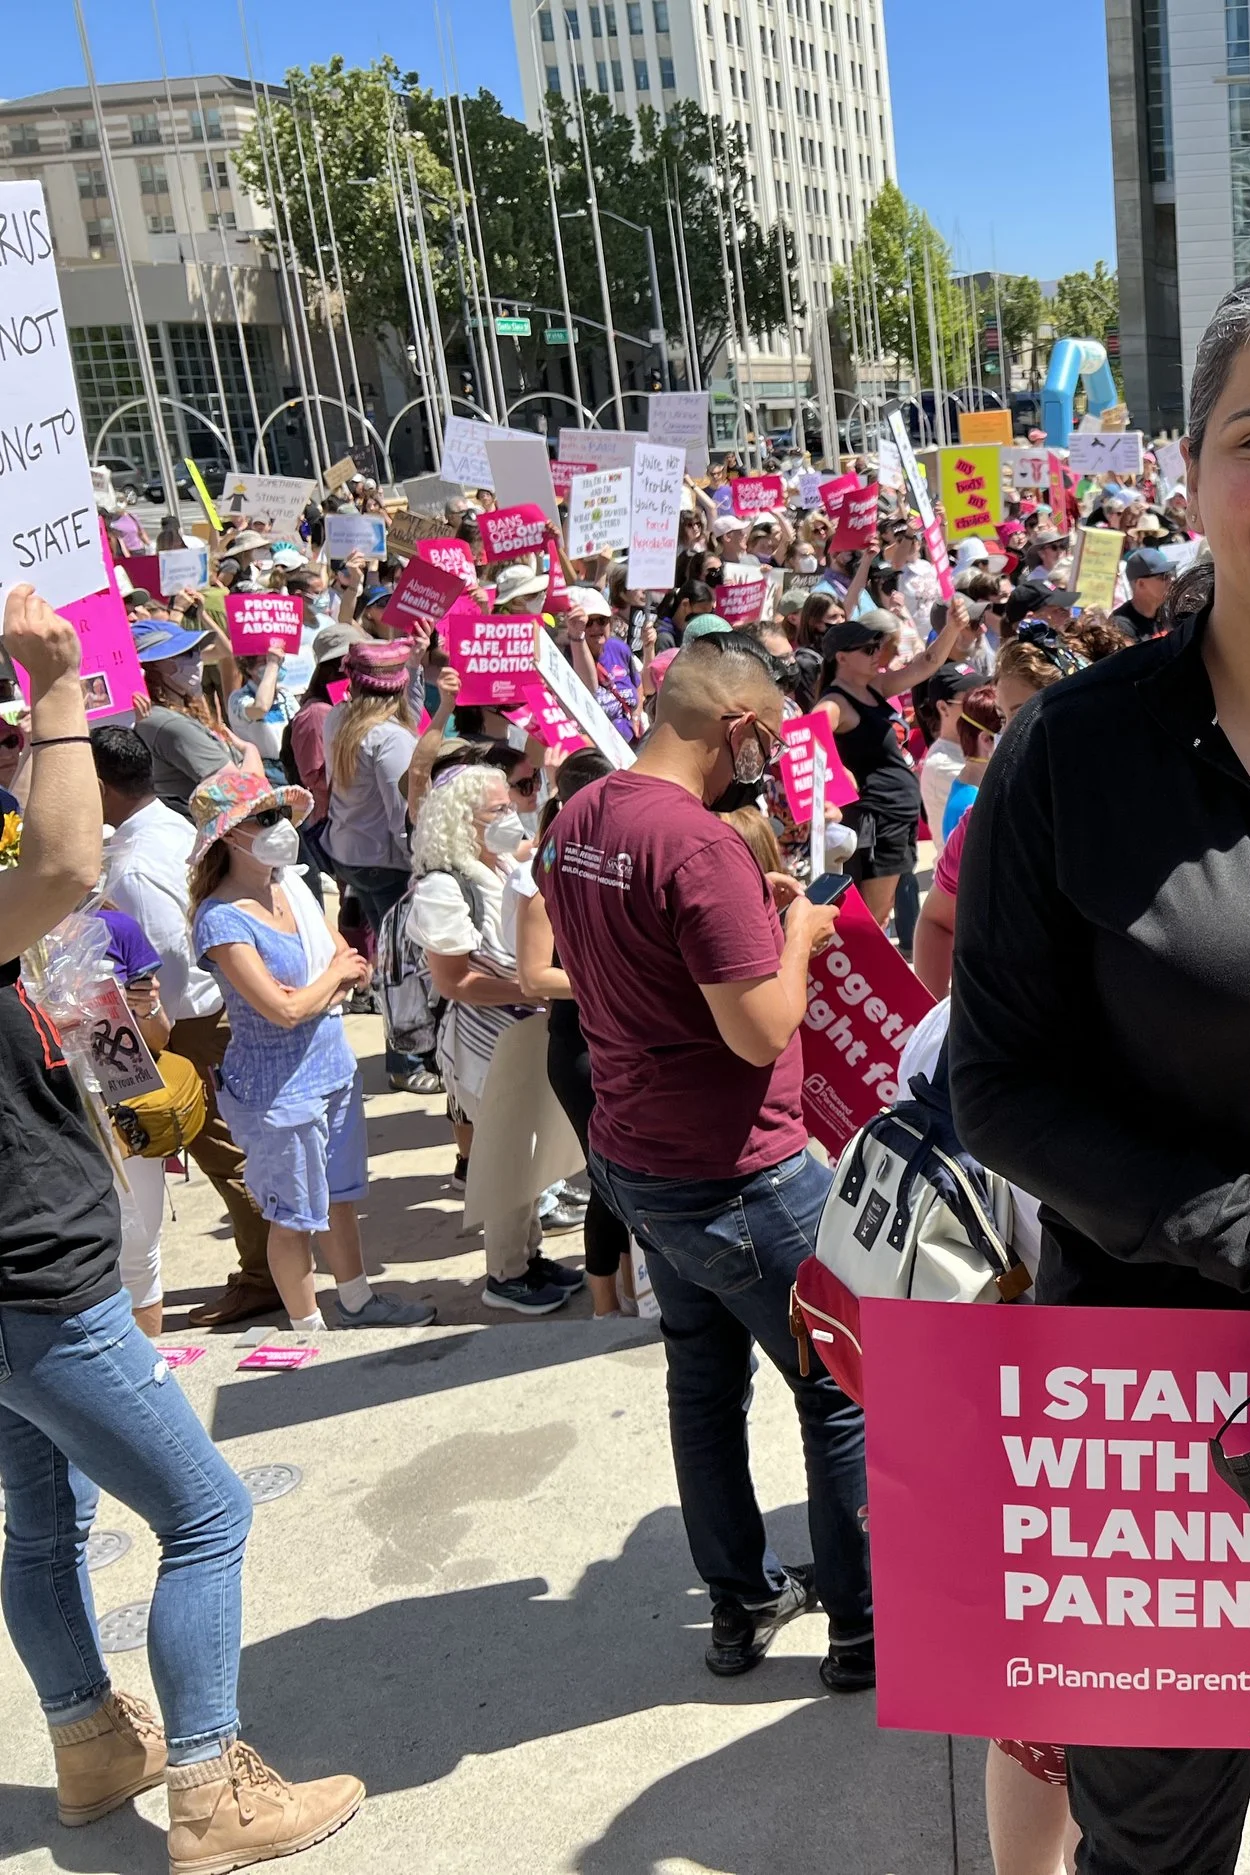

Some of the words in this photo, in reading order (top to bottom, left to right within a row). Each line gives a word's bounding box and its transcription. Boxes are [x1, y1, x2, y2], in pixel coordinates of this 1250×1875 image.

[0, 209, 52, 266] RUS
[0, 308, 58, 364] NOT
[39, 408, 75, 455] TO
[448, 452, 488, 477] VASE
[956, 478, 982, 493] body
[486, 514, 523, 533] BANS
[956, 512, 990, 530] choice
[12, 508, 92, 569] STATE
[489, 530, 515, 544] OFF
[492, 535, 544, 554] BODIES
[234, 611, 273, 623] SAFE,
[243, 599, 294, 612] PROTECT
[242, 622, 298, 636] ABORTION
[475, 622, 533, 639] PROTECT
[460, 639, 504, 657] SAFE,
[506, 639, 535, 656] LEGA
[826, 932, 916, 1052] Togeth
[804, 973, 869, 1068] ight
[108, 1080, 117, 1092] AT
[118, 1076, 135, 1088] YOUR
[135, 1069, 153, 1084] PERIL
[861, 1061, 899, 1105] fo
[819, 1090, 859, 1132] Parenthood
[825, 1085, 854, 1115] Planned
[1000, 1365, 1020, 1417] I
[1002, 1435, 1208, 1493] WITH
[1037, 1661, 1150, 1689] Planned
